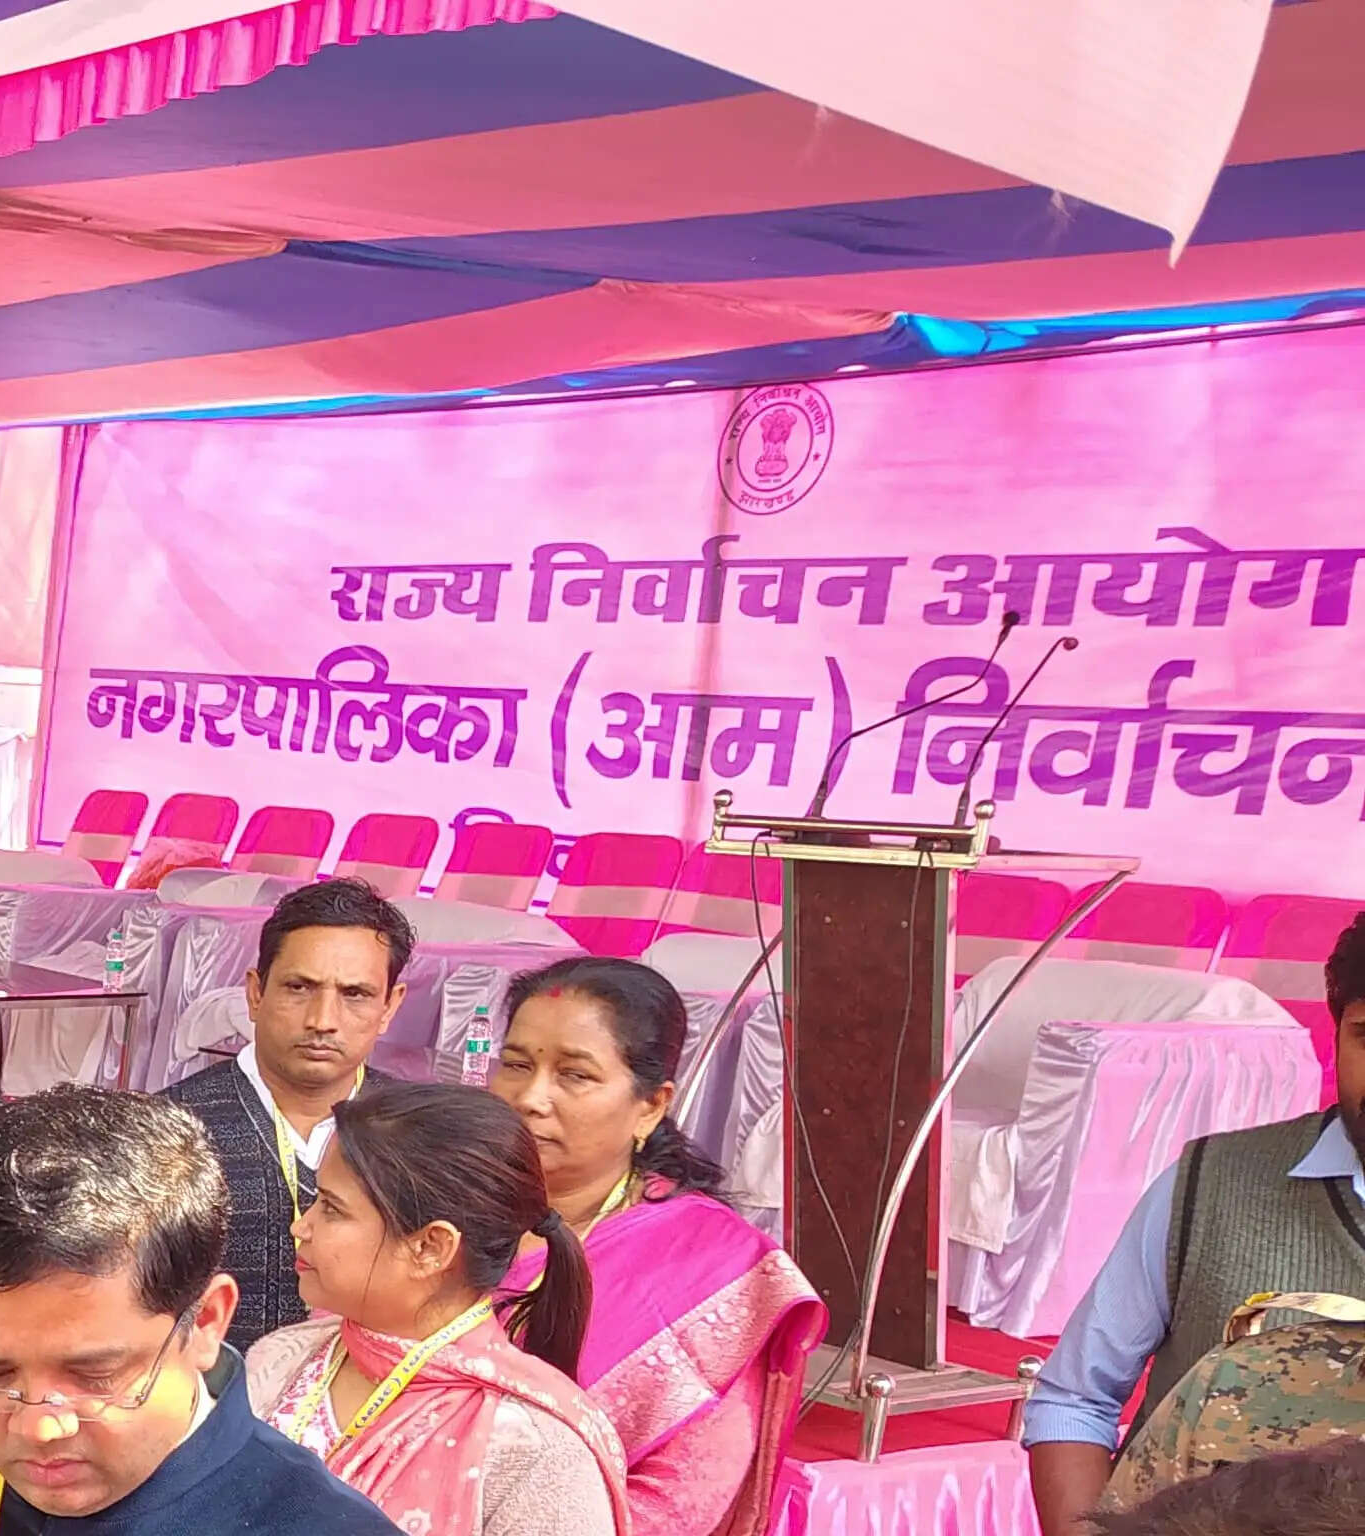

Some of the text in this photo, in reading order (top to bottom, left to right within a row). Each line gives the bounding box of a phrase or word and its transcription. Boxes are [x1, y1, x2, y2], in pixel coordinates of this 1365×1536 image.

[330, 526, 1365, 628] राज्य निर्वाचन आयोग
[86, 645, 528, 768] नगरपालिका
[550, 651, 854, 818] (आम)
